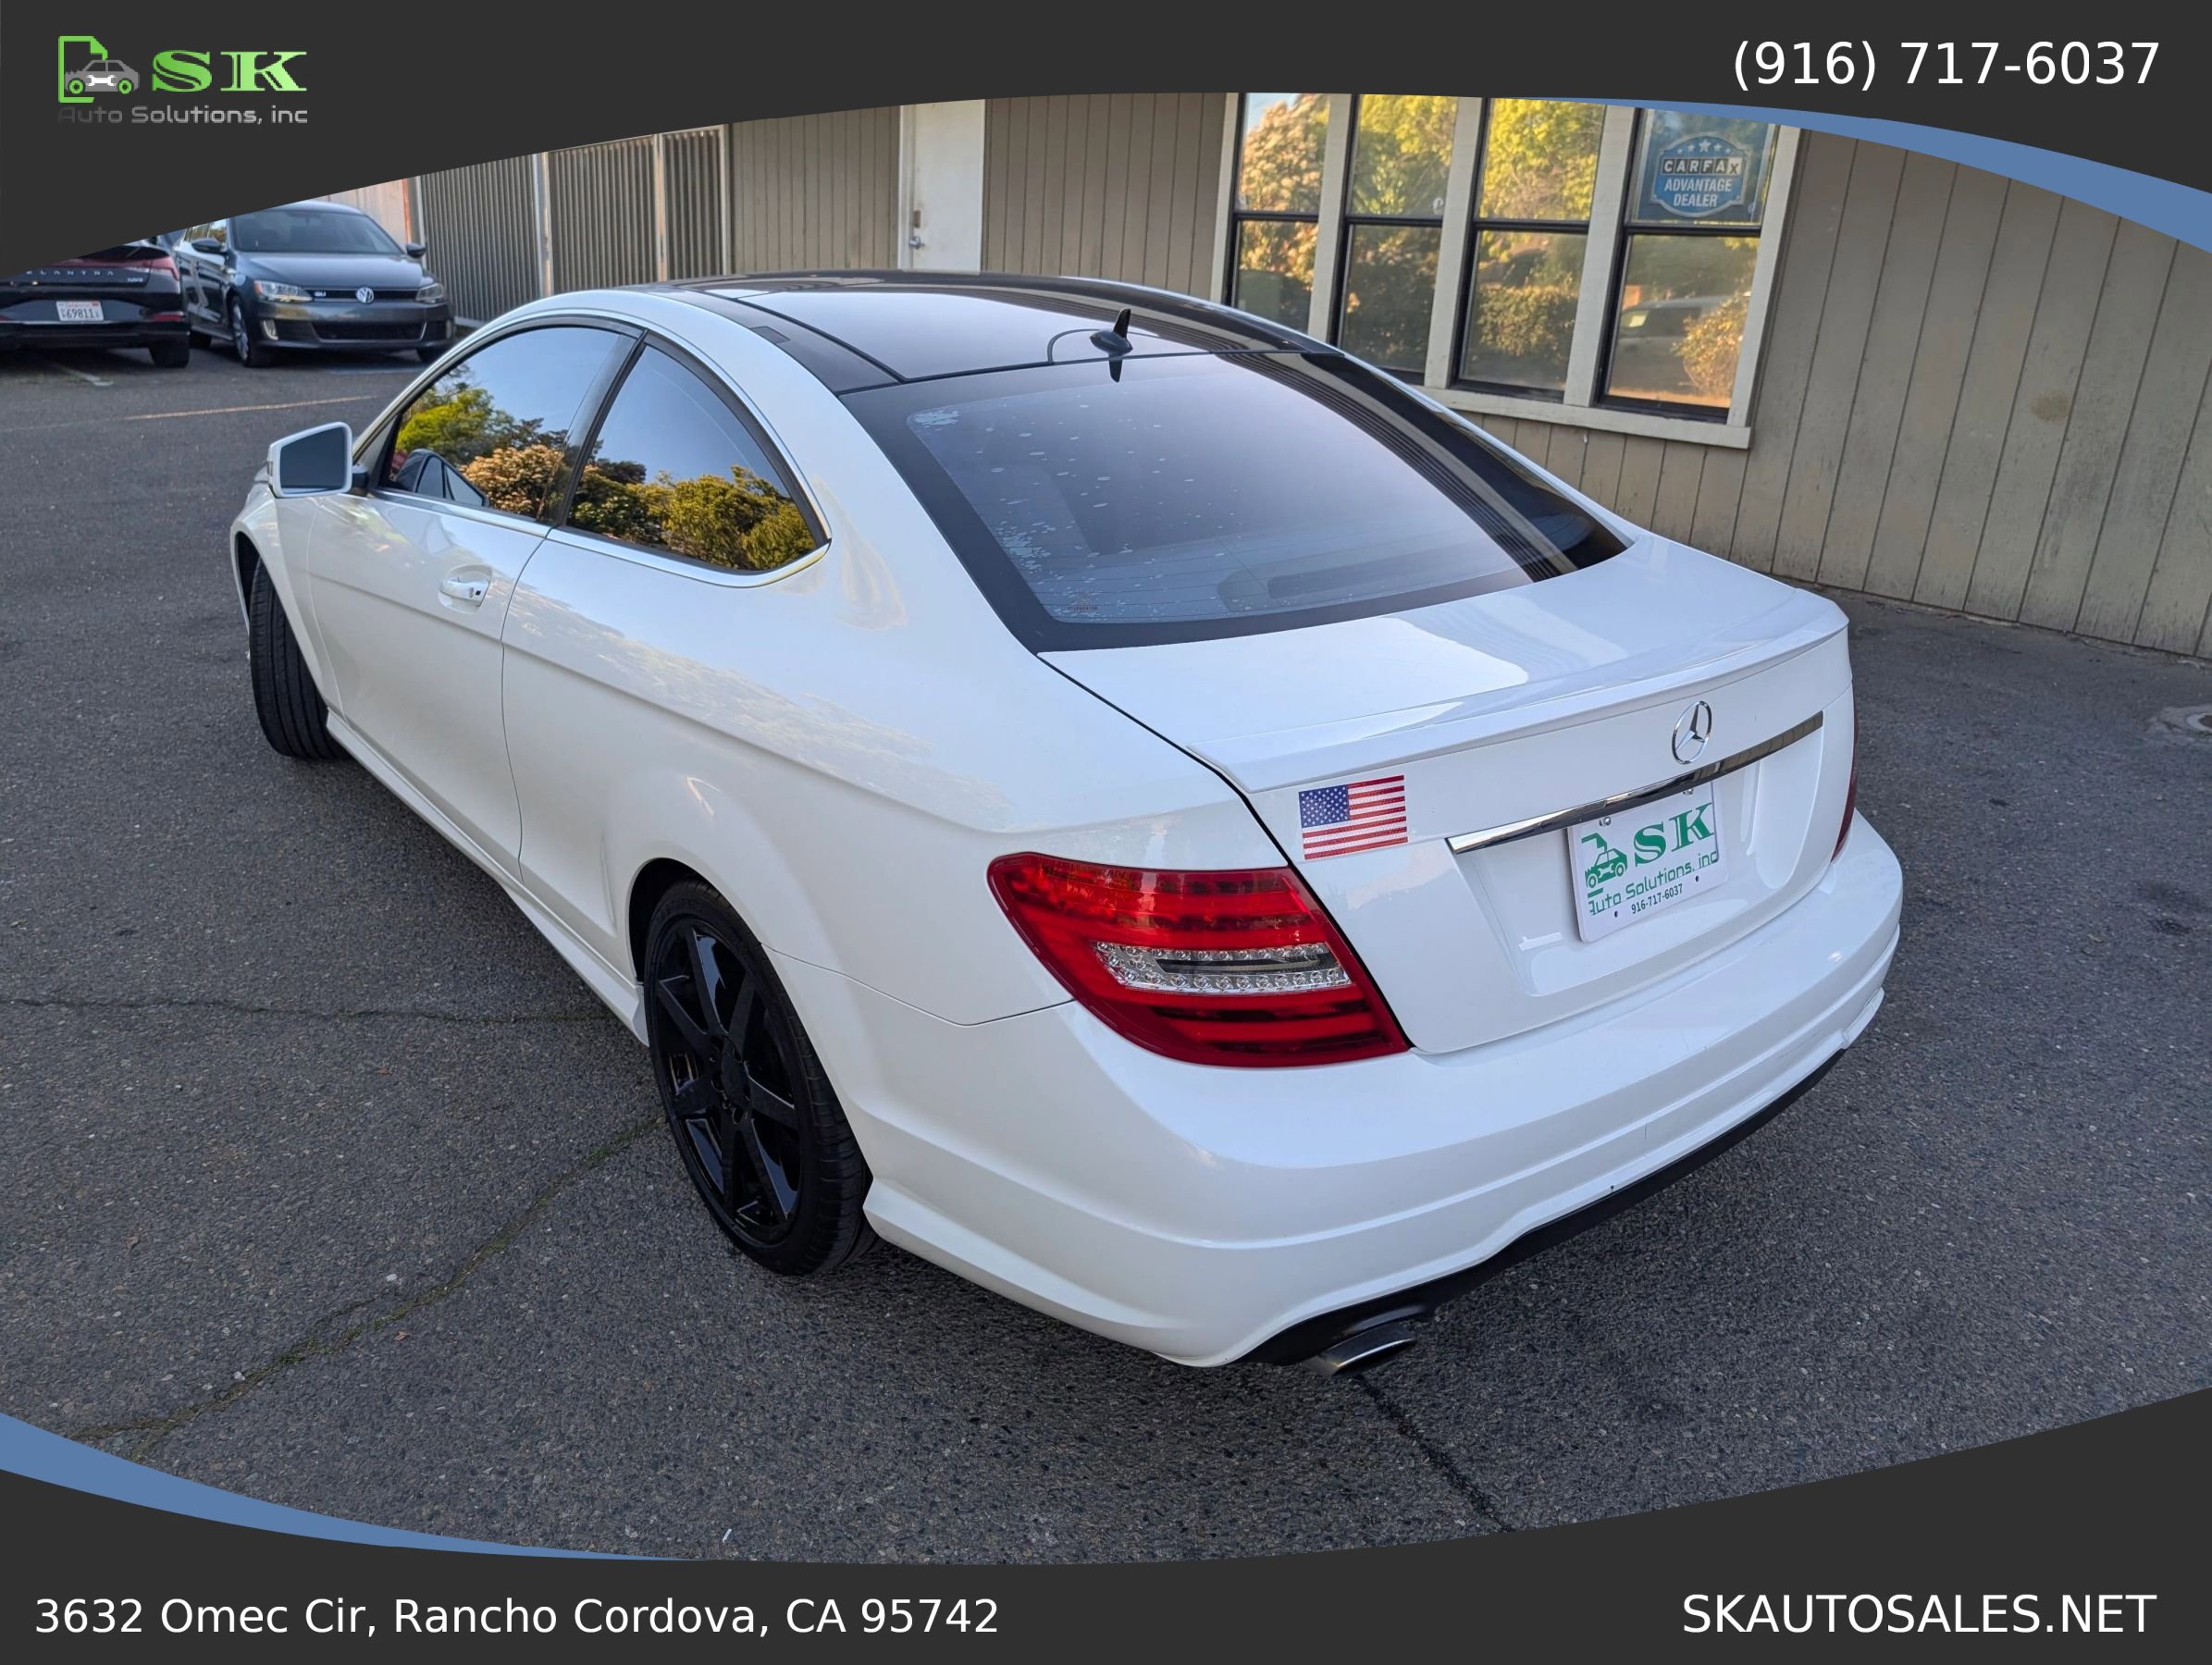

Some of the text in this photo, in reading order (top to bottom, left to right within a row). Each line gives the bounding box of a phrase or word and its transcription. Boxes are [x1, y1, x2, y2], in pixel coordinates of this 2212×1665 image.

[1663, 159, 1740, 175] CARFAX
[1664, 179, 1733, 192] ADVANTAGE
[1673, 193, 1718, 207] DEALER
[1633, 802, 1715, 868] SK
[1631, 883, 1684, 915] 916-717-6037
